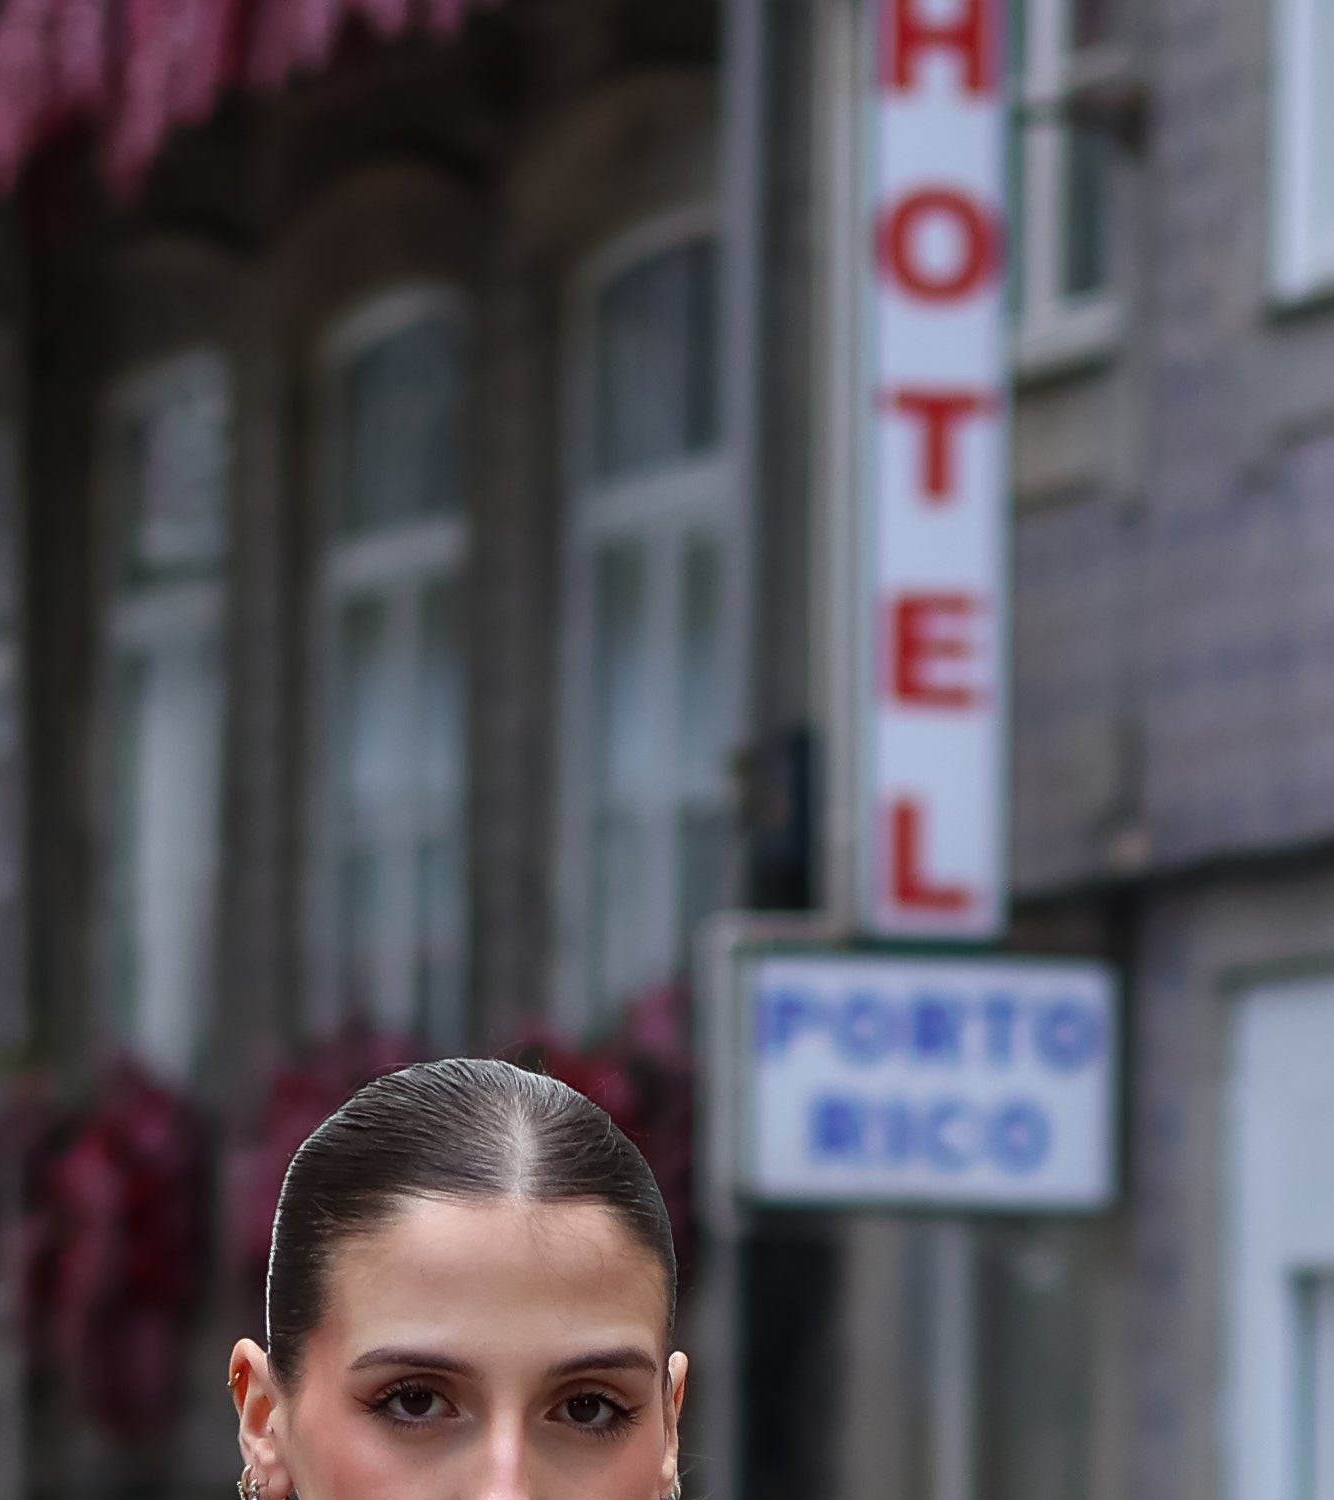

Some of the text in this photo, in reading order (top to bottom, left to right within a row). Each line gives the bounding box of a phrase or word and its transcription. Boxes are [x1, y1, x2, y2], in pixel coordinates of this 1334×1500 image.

[877, 0, 997, 914] HOTEL
[757, 987, 1105, 1073] PORTO
[809, 1092, 1052, 1173] RICO
